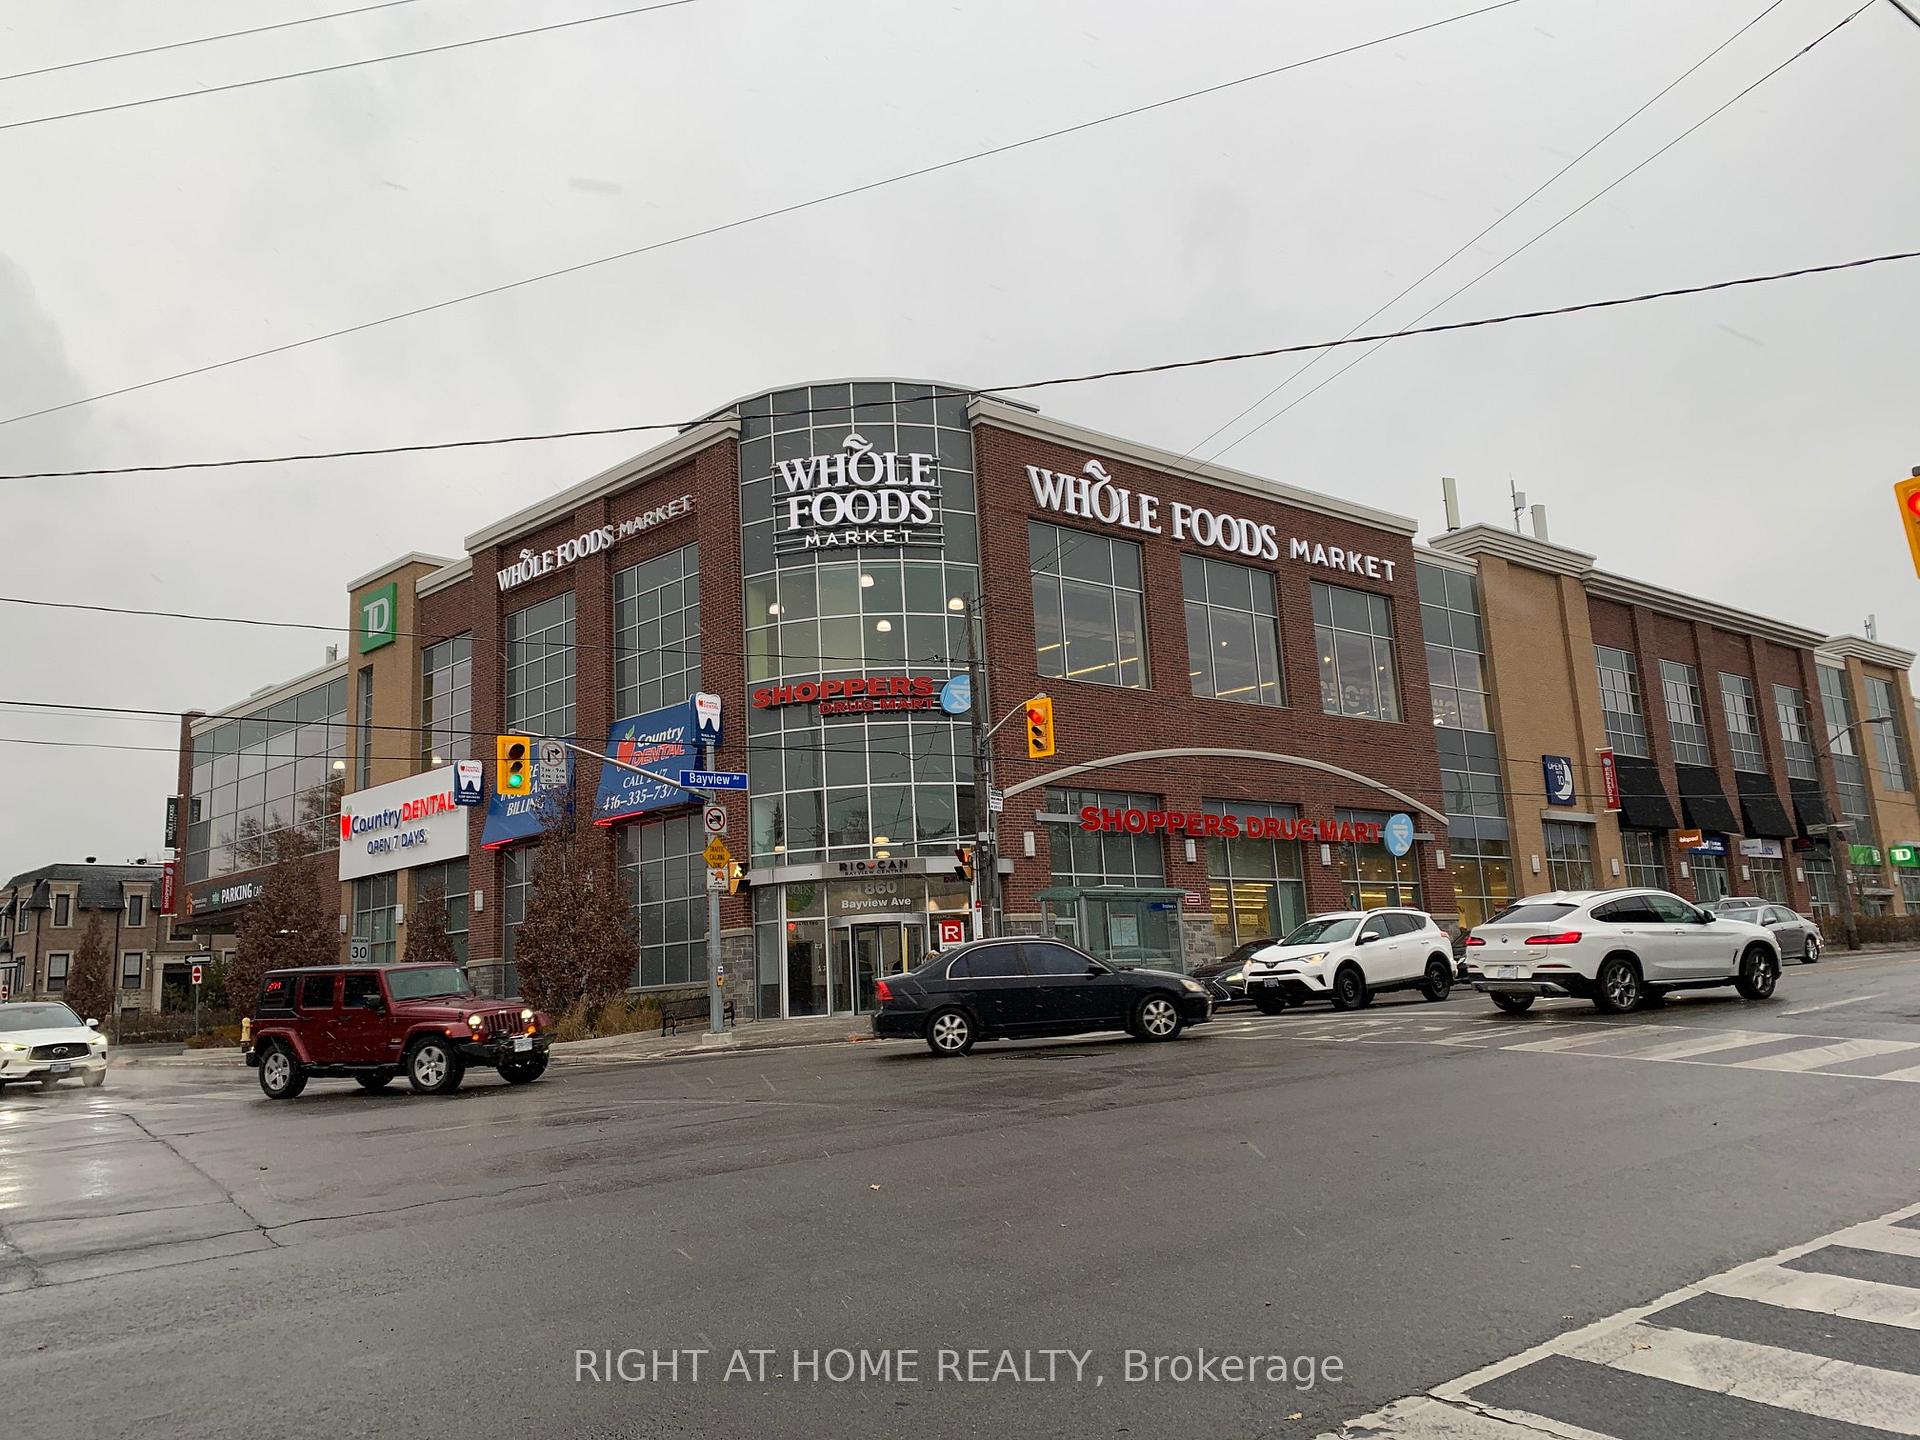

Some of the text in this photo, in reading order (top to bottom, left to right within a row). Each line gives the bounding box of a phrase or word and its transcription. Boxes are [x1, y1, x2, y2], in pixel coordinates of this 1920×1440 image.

[776, 438, 935, 492] WHOLE
[786, 489, 933, 530] FOODS
[1025, 460, 1396, 581] WHOLE FOODS MARKET
[497, 495, 693, 591] WHOLE FOODS MARKET
[805, 530, 912, 549] MARKET
[364, 598, 390, 639] TD
[752, 676, 934, 709] SHOPPERS
[818, 698, 934, 714] DRUG MART
[637, 726, 685, 747] Country
[631, 740, 686, 766] DENTAL
[622, 775, 643, 789] CALL
[689, 772, 731, 786] Bayview
[1557, 775, 1565, 785] 10
[352, 808, 402, 834] Country
[402, 791, 457, 821] DENTAL
[506, 794, 546, 816] BILLING
[1079, 806, 1382, 844] SHOPPERS DRUG MART
[367, 829, 425, 855] OPEN 7 DAYS
[1891, 849, 1911, 861] TD
[839, 860, 908, 872] RIO CAN
[222, 883, 253, 904] PARKING
[841, 897, 912, 910] Bayview Ave
[944, 925, 959, 940] R
[352, 946, 368, 958] 30
